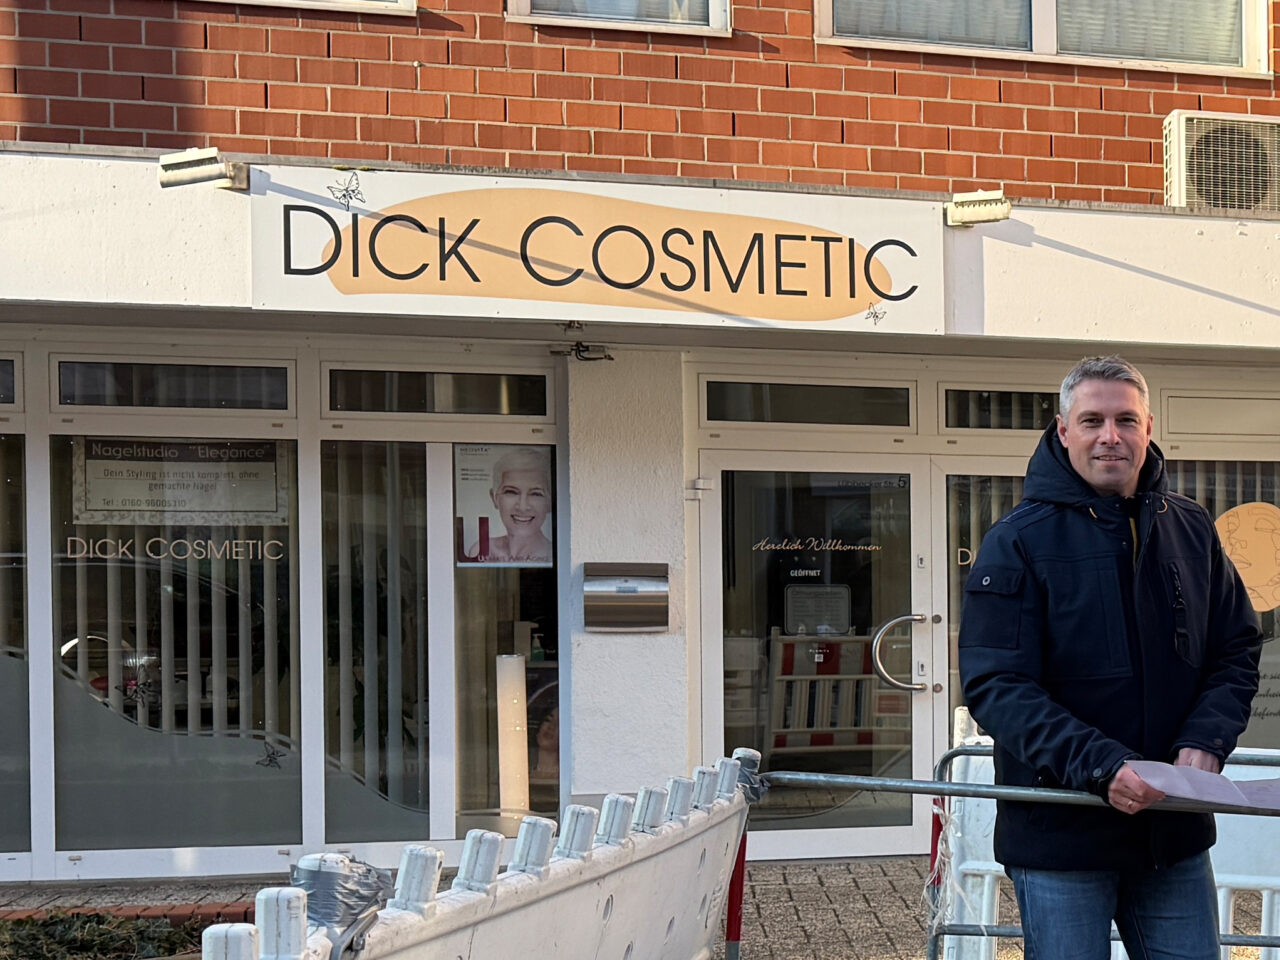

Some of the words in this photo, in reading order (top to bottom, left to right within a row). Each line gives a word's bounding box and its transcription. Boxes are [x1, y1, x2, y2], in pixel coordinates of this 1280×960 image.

[284, 204, 482, 282] DICK
[519, 215, 919, 302] COSMETIC
[92, 442, 179, 459] Nagelstudio
[67, 537, 134, 559] DICK
[146, 537, 284, 560] COSMETIC
[805, 537, 882, 551] Willkommen
[790, 568, 821, 577] GEÖFFNET
